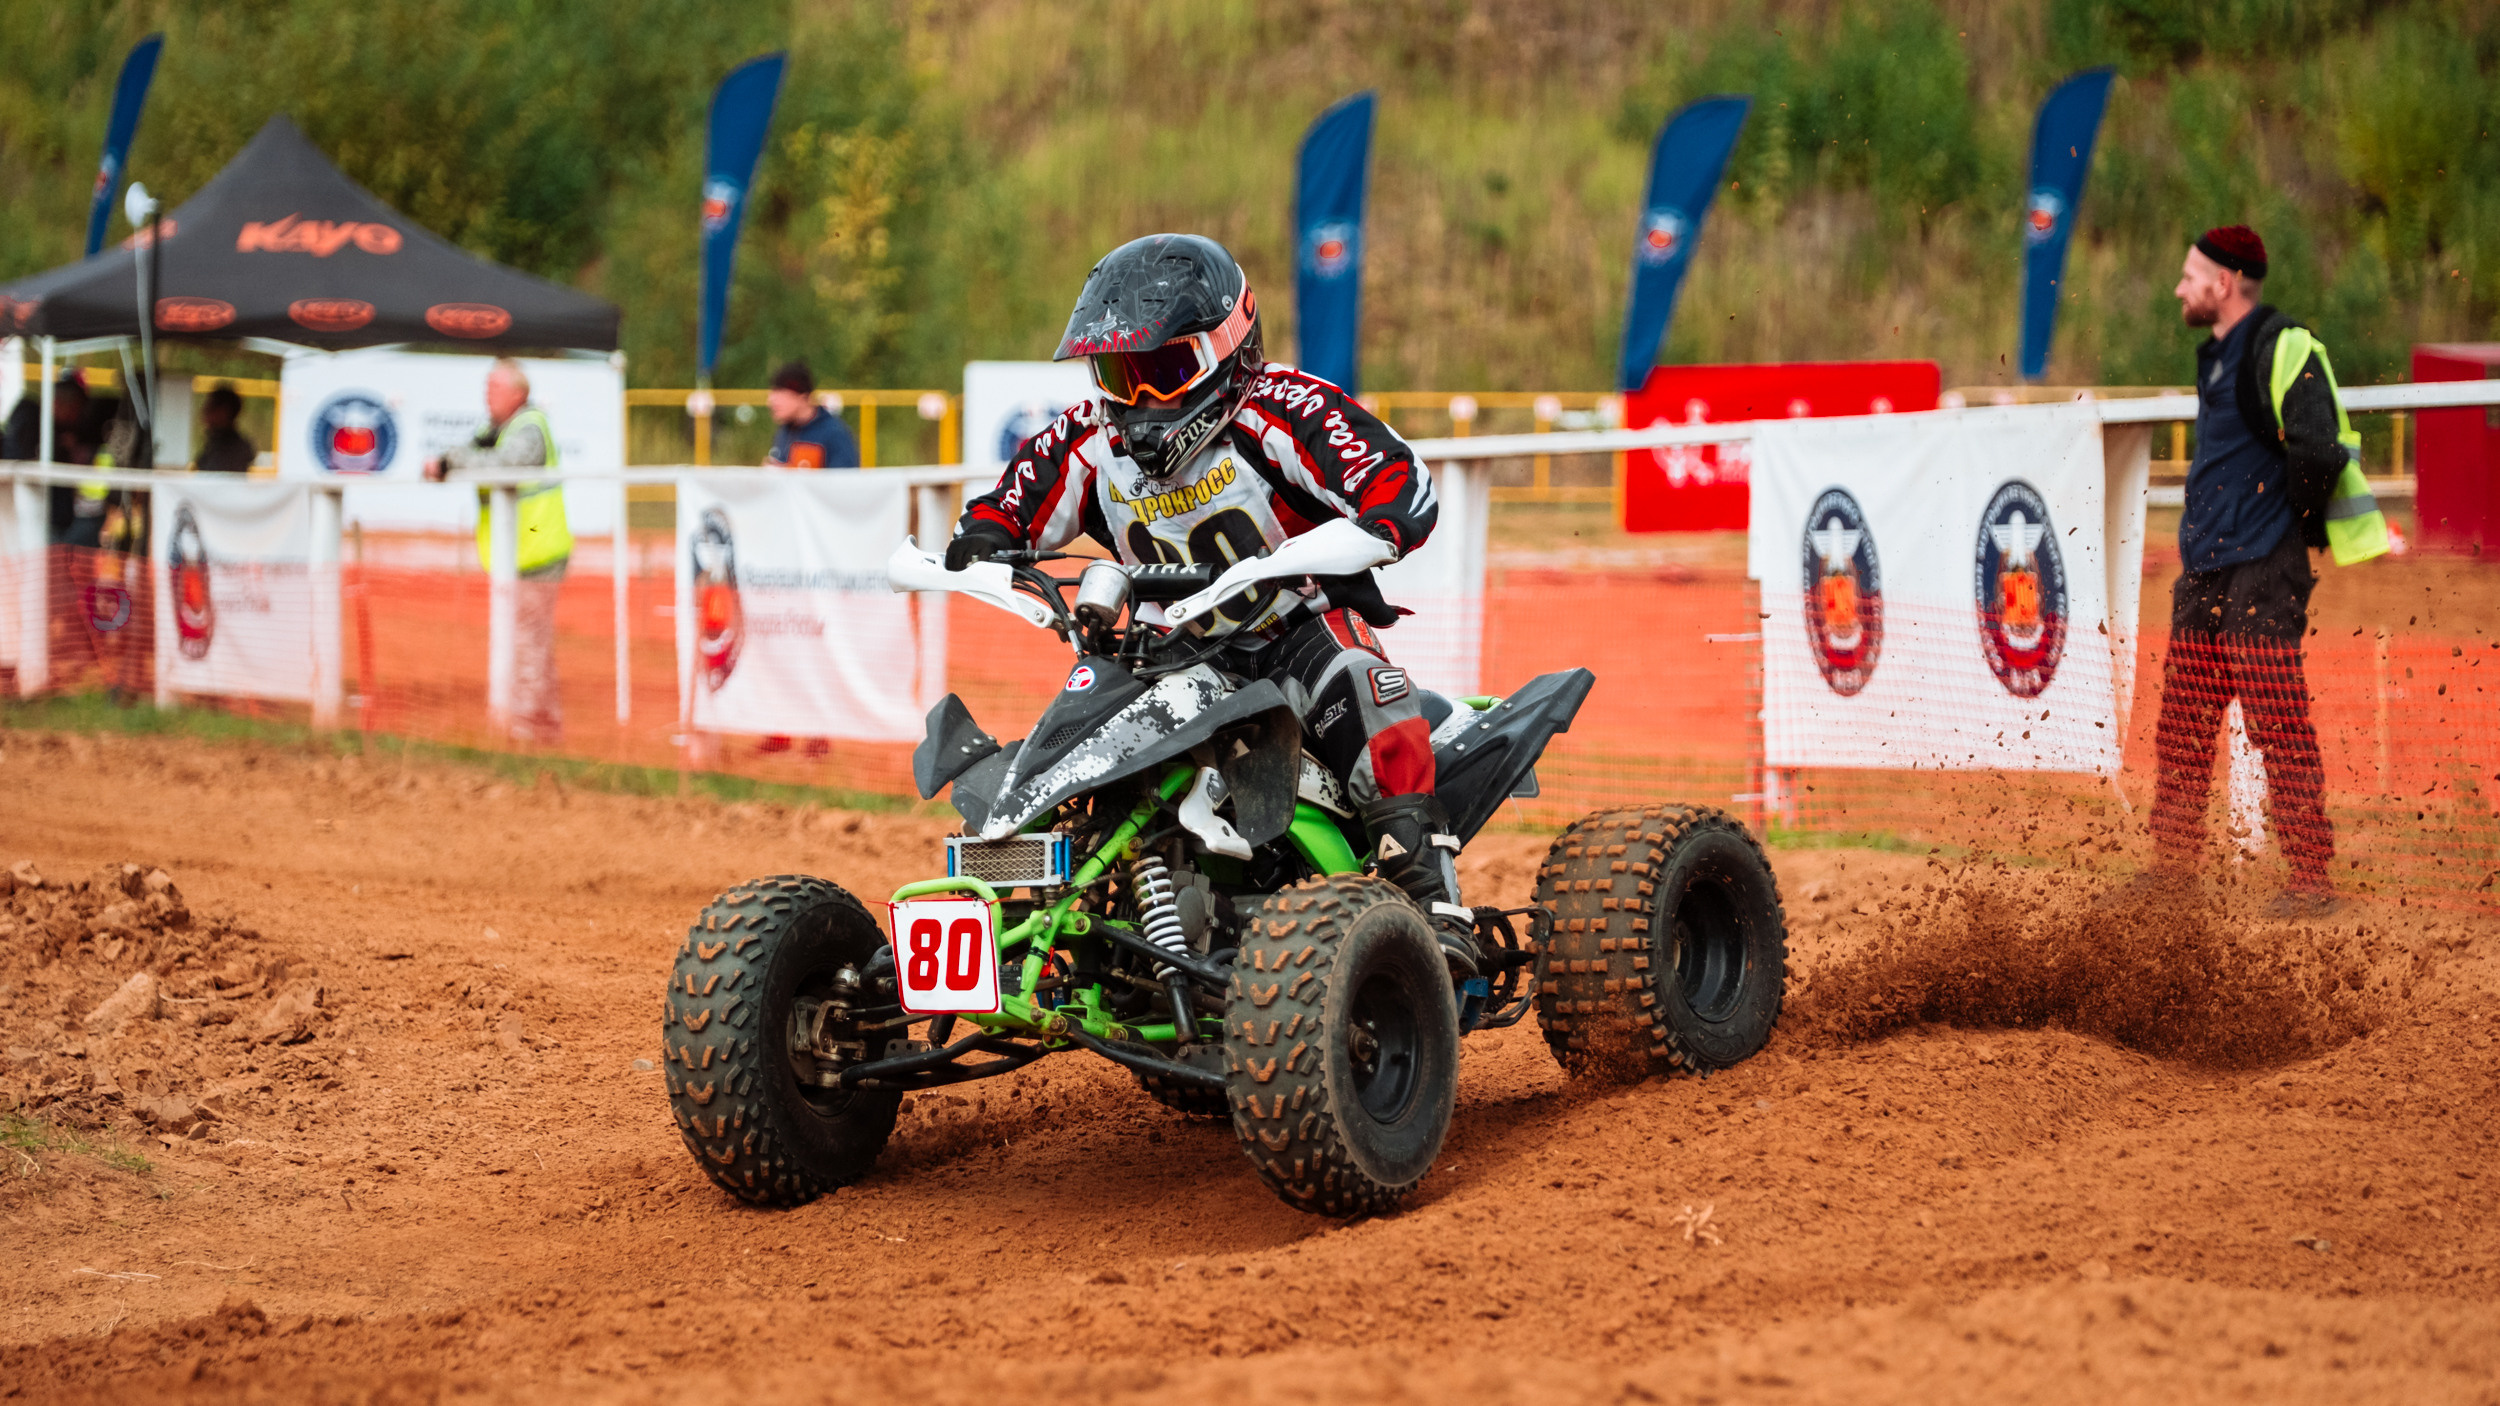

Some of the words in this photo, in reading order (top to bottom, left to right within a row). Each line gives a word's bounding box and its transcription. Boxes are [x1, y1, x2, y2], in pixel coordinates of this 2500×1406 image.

[236, 211, 404, 258] KAYO
[1108, 457, 1237, 526] КДРОКРОСС
[907, 917, 984, 992] 80
